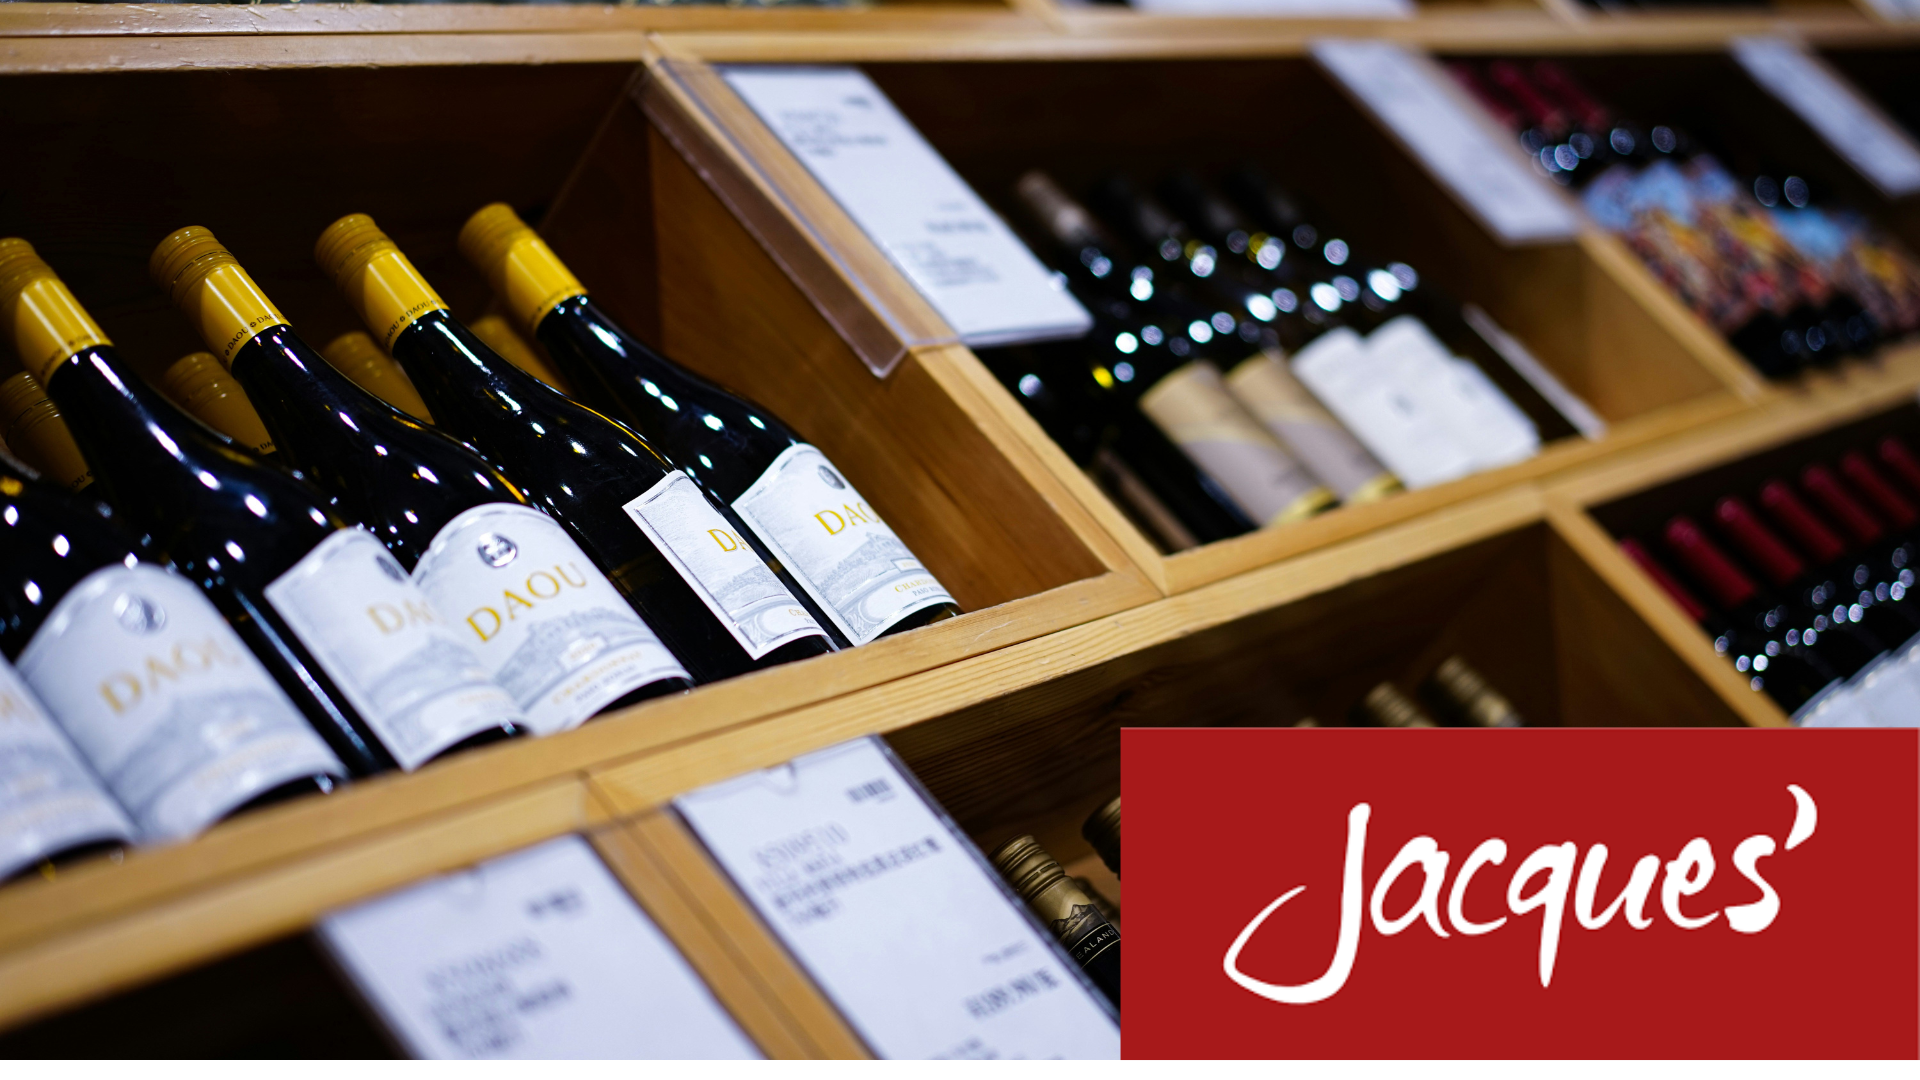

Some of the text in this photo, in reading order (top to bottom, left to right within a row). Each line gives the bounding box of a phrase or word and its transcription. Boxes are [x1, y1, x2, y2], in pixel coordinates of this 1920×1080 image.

[406, 301, 430, 317] DAOU
[228, 326, 249, 350] DAOU
[466, 562, 587, 642] DAOU
